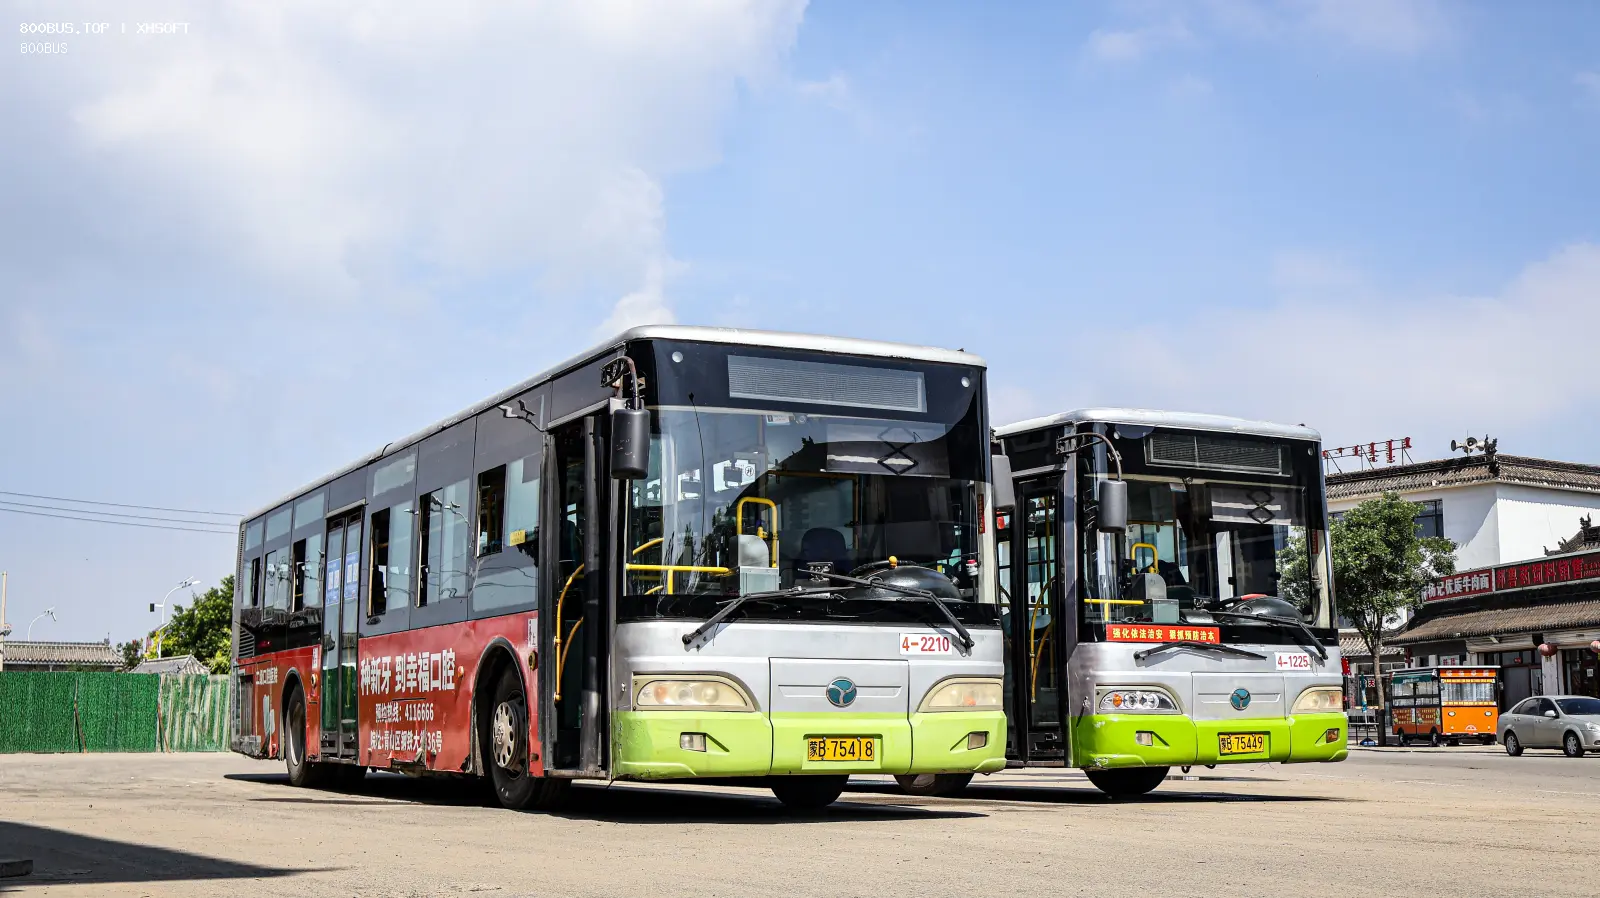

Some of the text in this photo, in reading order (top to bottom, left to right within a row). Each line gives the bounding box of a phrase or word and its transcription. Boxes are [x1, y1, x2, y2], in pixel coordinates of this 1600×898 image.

[1112, 628, 1163, 640] 强化依法治安
[902, 636, 950, 652] 4-2210
[1277, 654, 1309, 668] 4-1225
[361, 656, 392, 696] 种新牙
[395, 648, 456, 694] 到幸福口腔
[404, 703, 434, 721] 4116666
